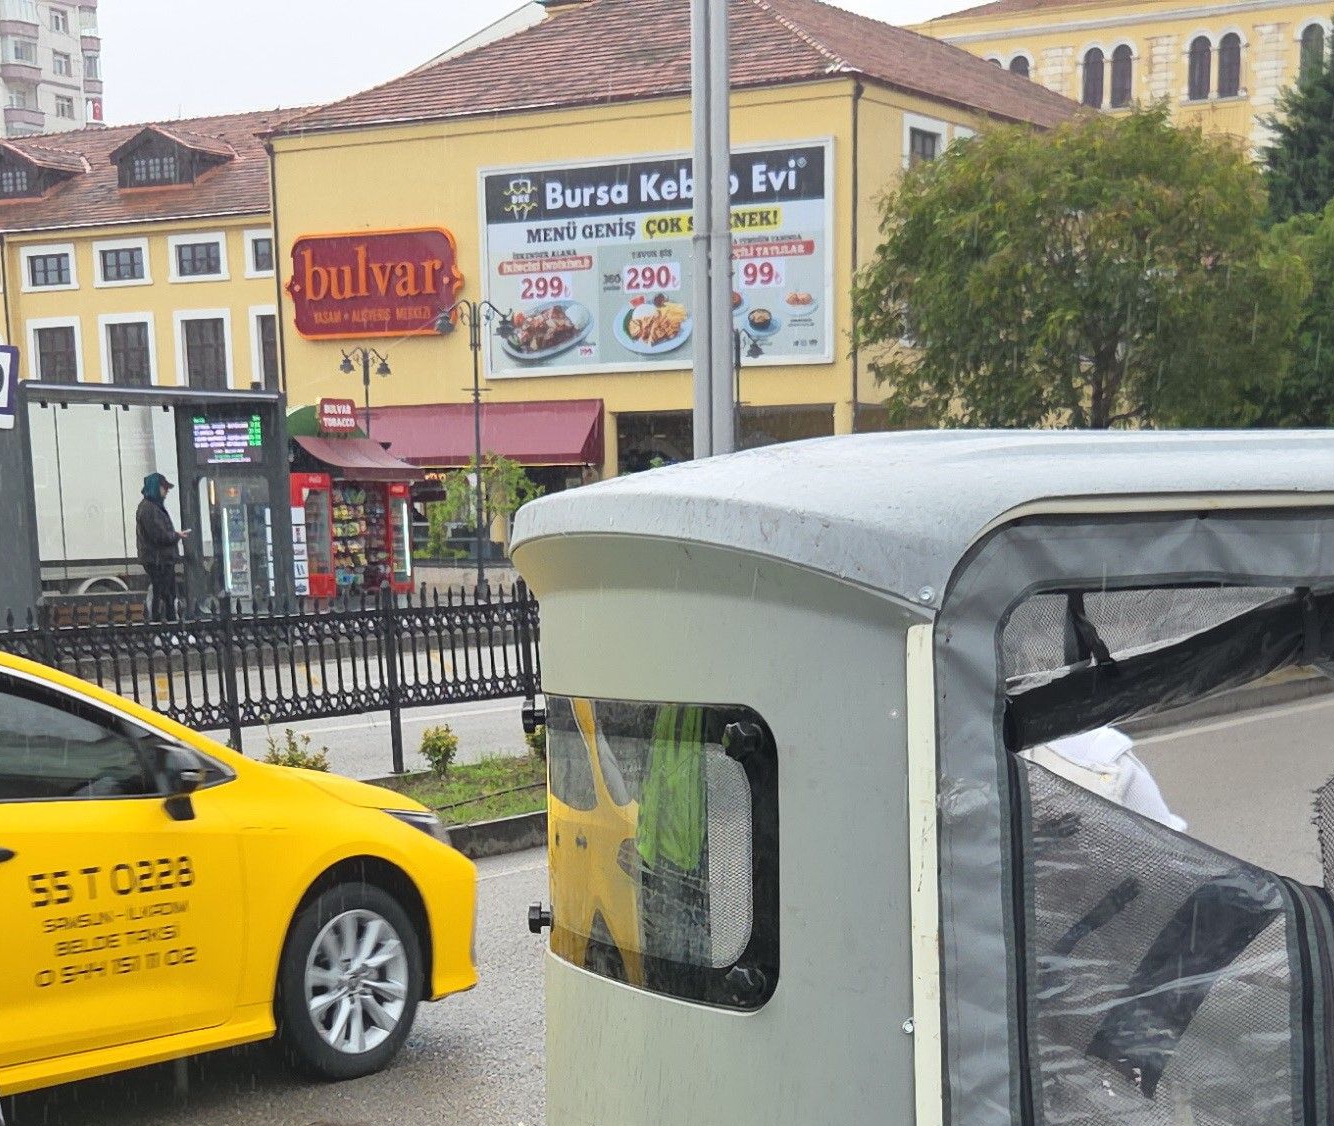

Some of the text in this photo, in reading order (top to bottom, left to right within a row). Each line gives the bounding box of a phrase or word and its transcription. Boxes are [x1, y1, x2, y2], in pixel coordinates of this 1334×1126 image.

[545, 181, 629, 210] Bursa
[752, 158, 796, 193] Evi
[526, 217, 578, 244] MENÜ
[581, 217, 636, 240] GENİŞ
[645, 215, 680, 240] ÇOK
[300, 245, 443, 301] bulvar
[28, 870, 75, 908] 55
[79, 866, 101, 900] T
